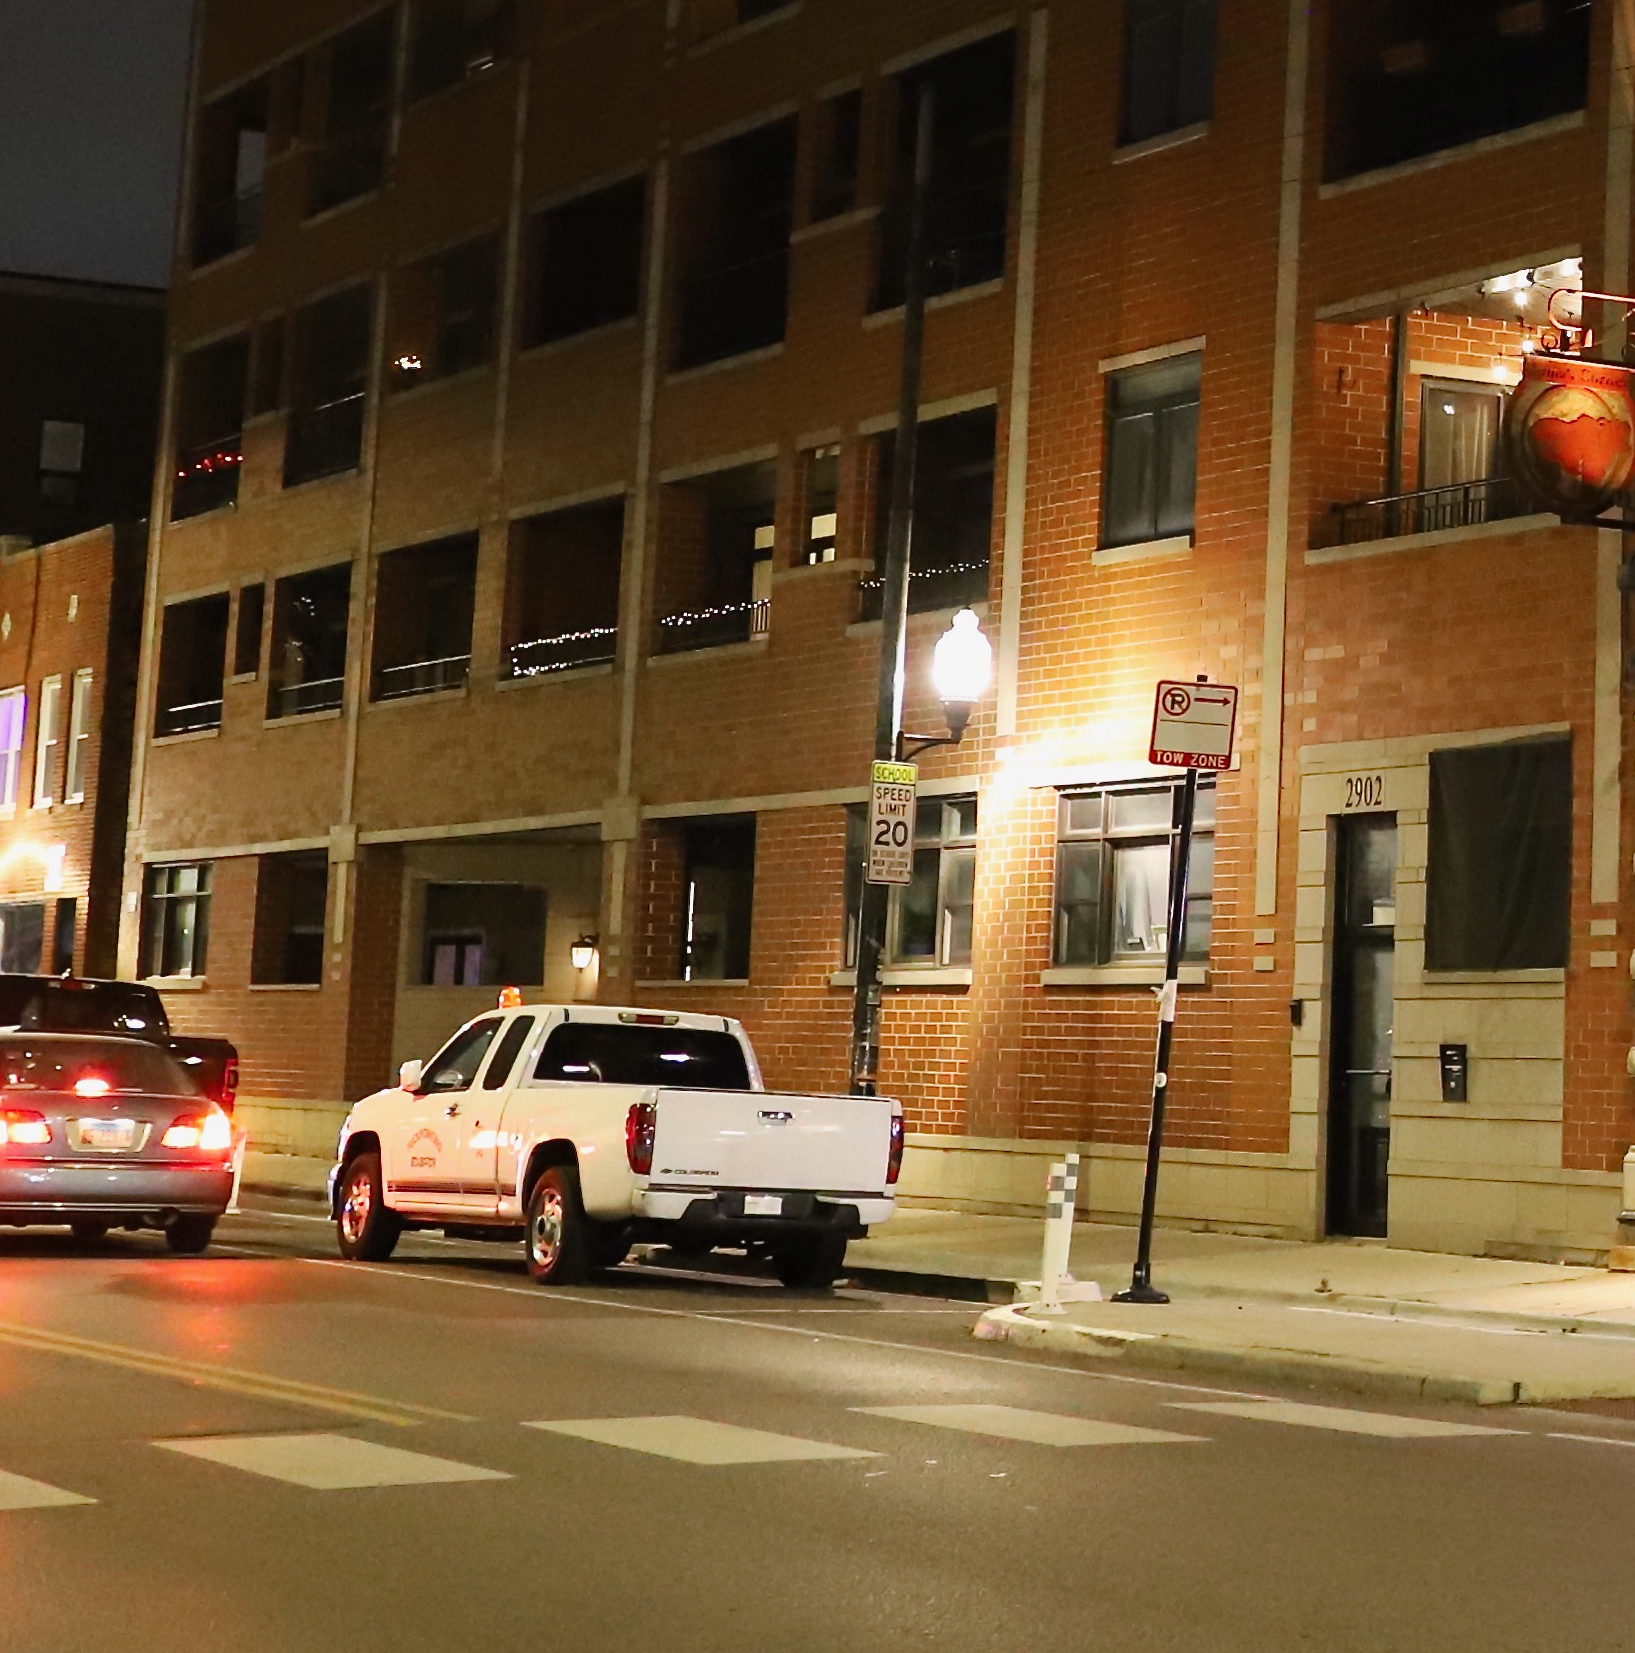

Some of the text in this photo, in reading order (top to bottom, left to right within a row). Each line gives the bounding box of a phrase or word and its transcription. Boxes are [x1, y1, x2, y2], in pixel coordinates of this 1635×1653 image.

[1156, 751, 1226, 768] TOW ZONE
[875, 766, 914, 783] SCHOOL
[875, 786, 912, 803] SPEED
[1345, 775, 1383, 808] 2902
[878, 804, 907, 817] LIMIT
[874, 819, 909, 848] 20
